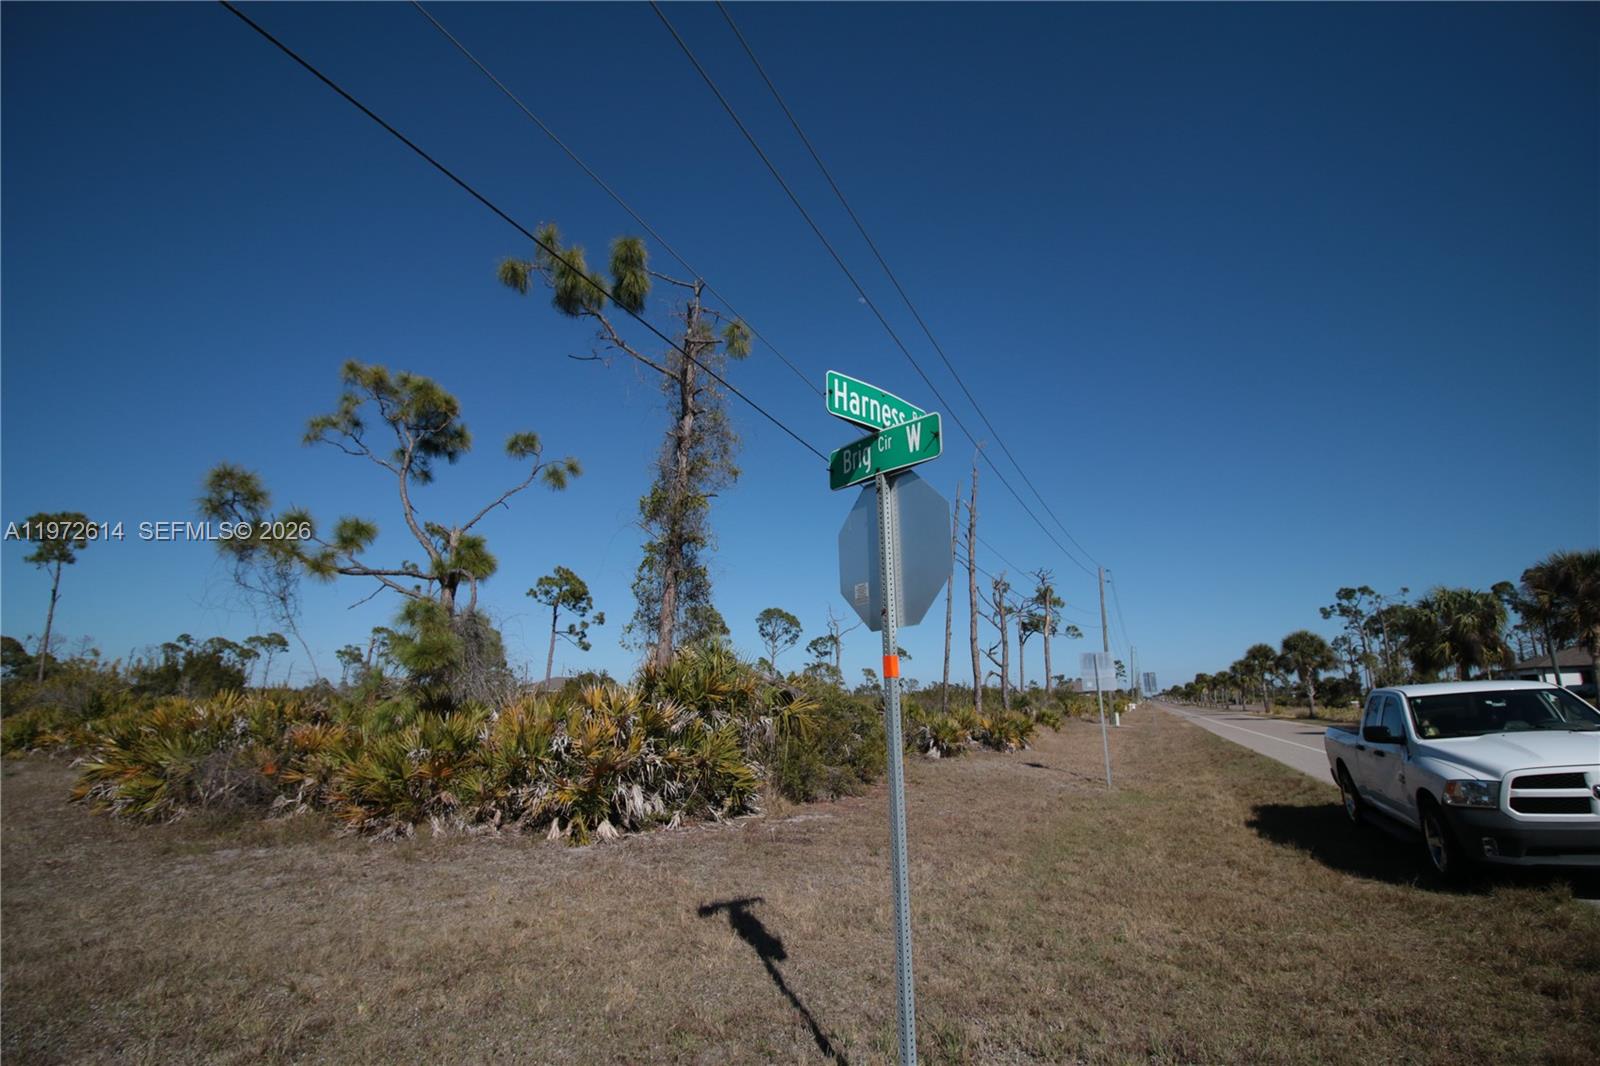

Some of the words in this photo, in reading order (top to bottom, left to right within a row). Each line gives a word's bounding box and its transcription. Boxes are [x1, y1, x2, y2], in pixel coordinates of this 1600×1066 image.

[834, 378, 906, 427] Harness
[843, 445, 871, 474] Brig
[877, 435, 892, 452] Cir
[905, 422, 922, 453] W
